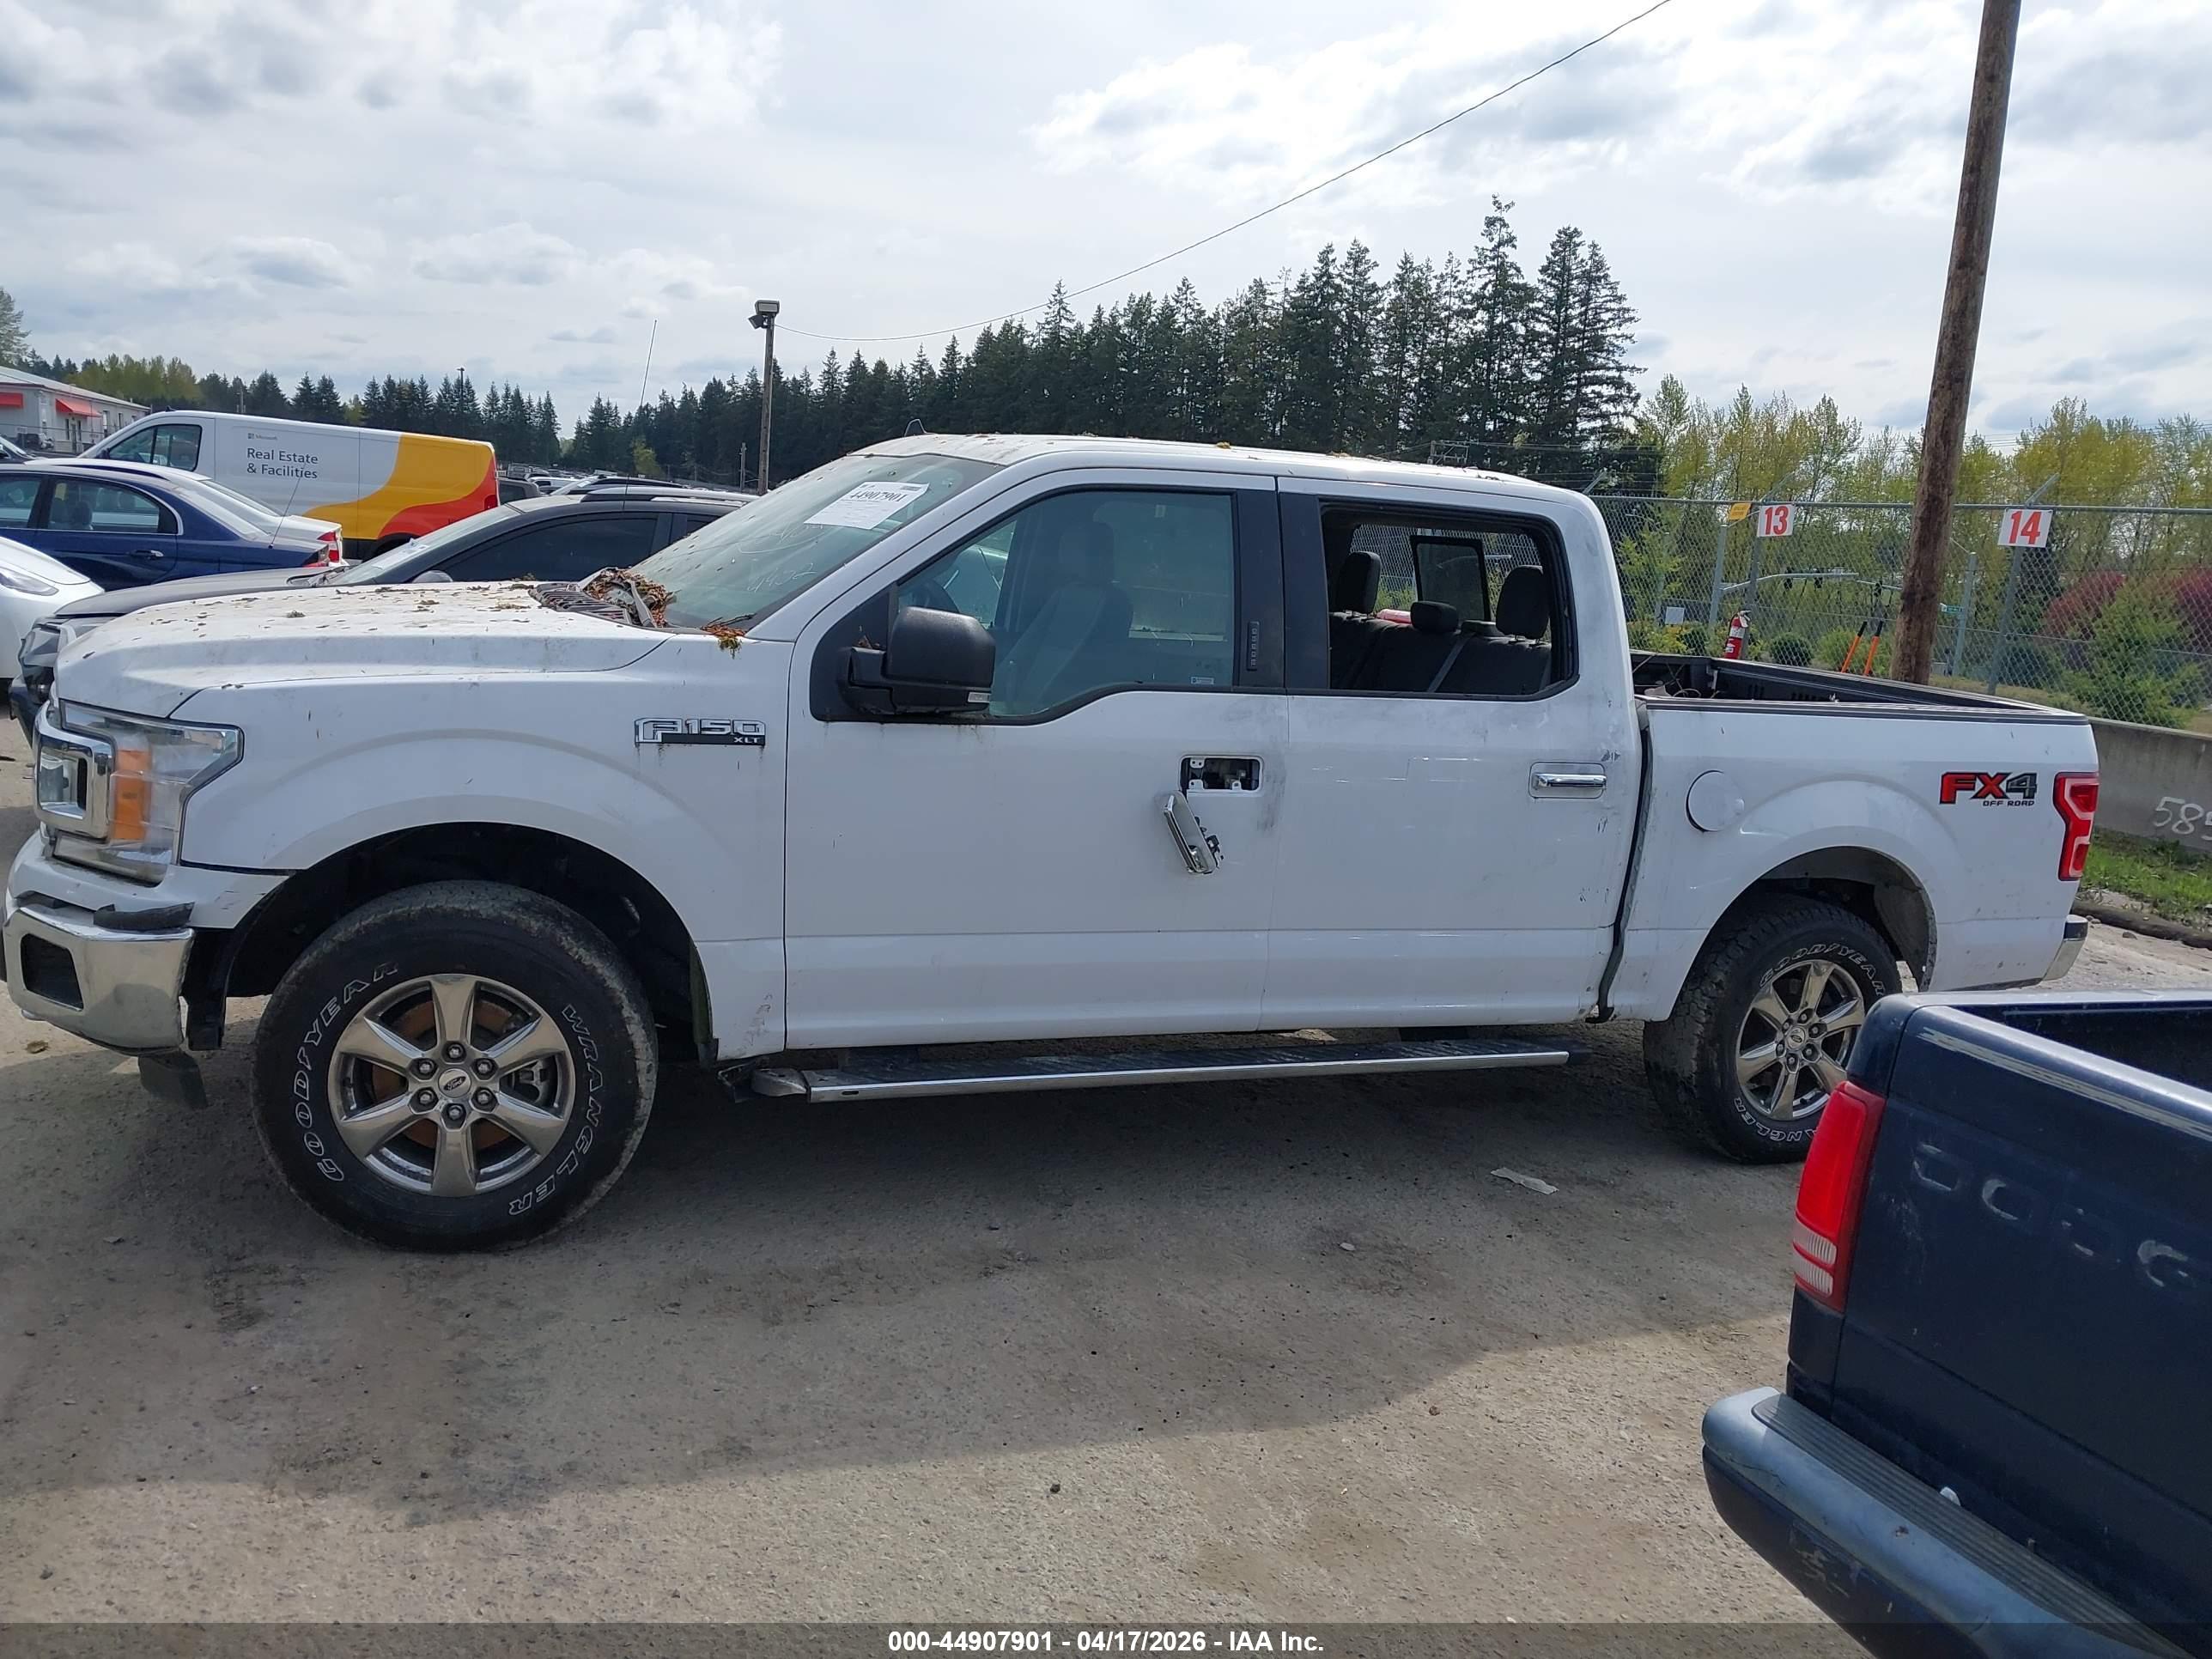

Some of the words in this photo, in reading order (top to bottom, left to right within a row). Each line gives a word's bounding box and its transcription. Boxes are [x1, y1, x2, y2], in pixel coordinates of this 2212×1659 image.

[246, 447, 274, 460] Real
[279, 451, 319, 464] Estate
[246, 463, 257, 474] &
[261, 465, 318, 478] Facilities
[1765, 506, 1790, 536] 13
[2009, 510, 2042, 544] 14
[1939, 771, 2038, 805] FX4
[1759, 943, 1885, 996] GOODYEAR
[294, 961, 398, 1182] GOODYEAR
[508, 1003, 603, 1216] WRANGLER
